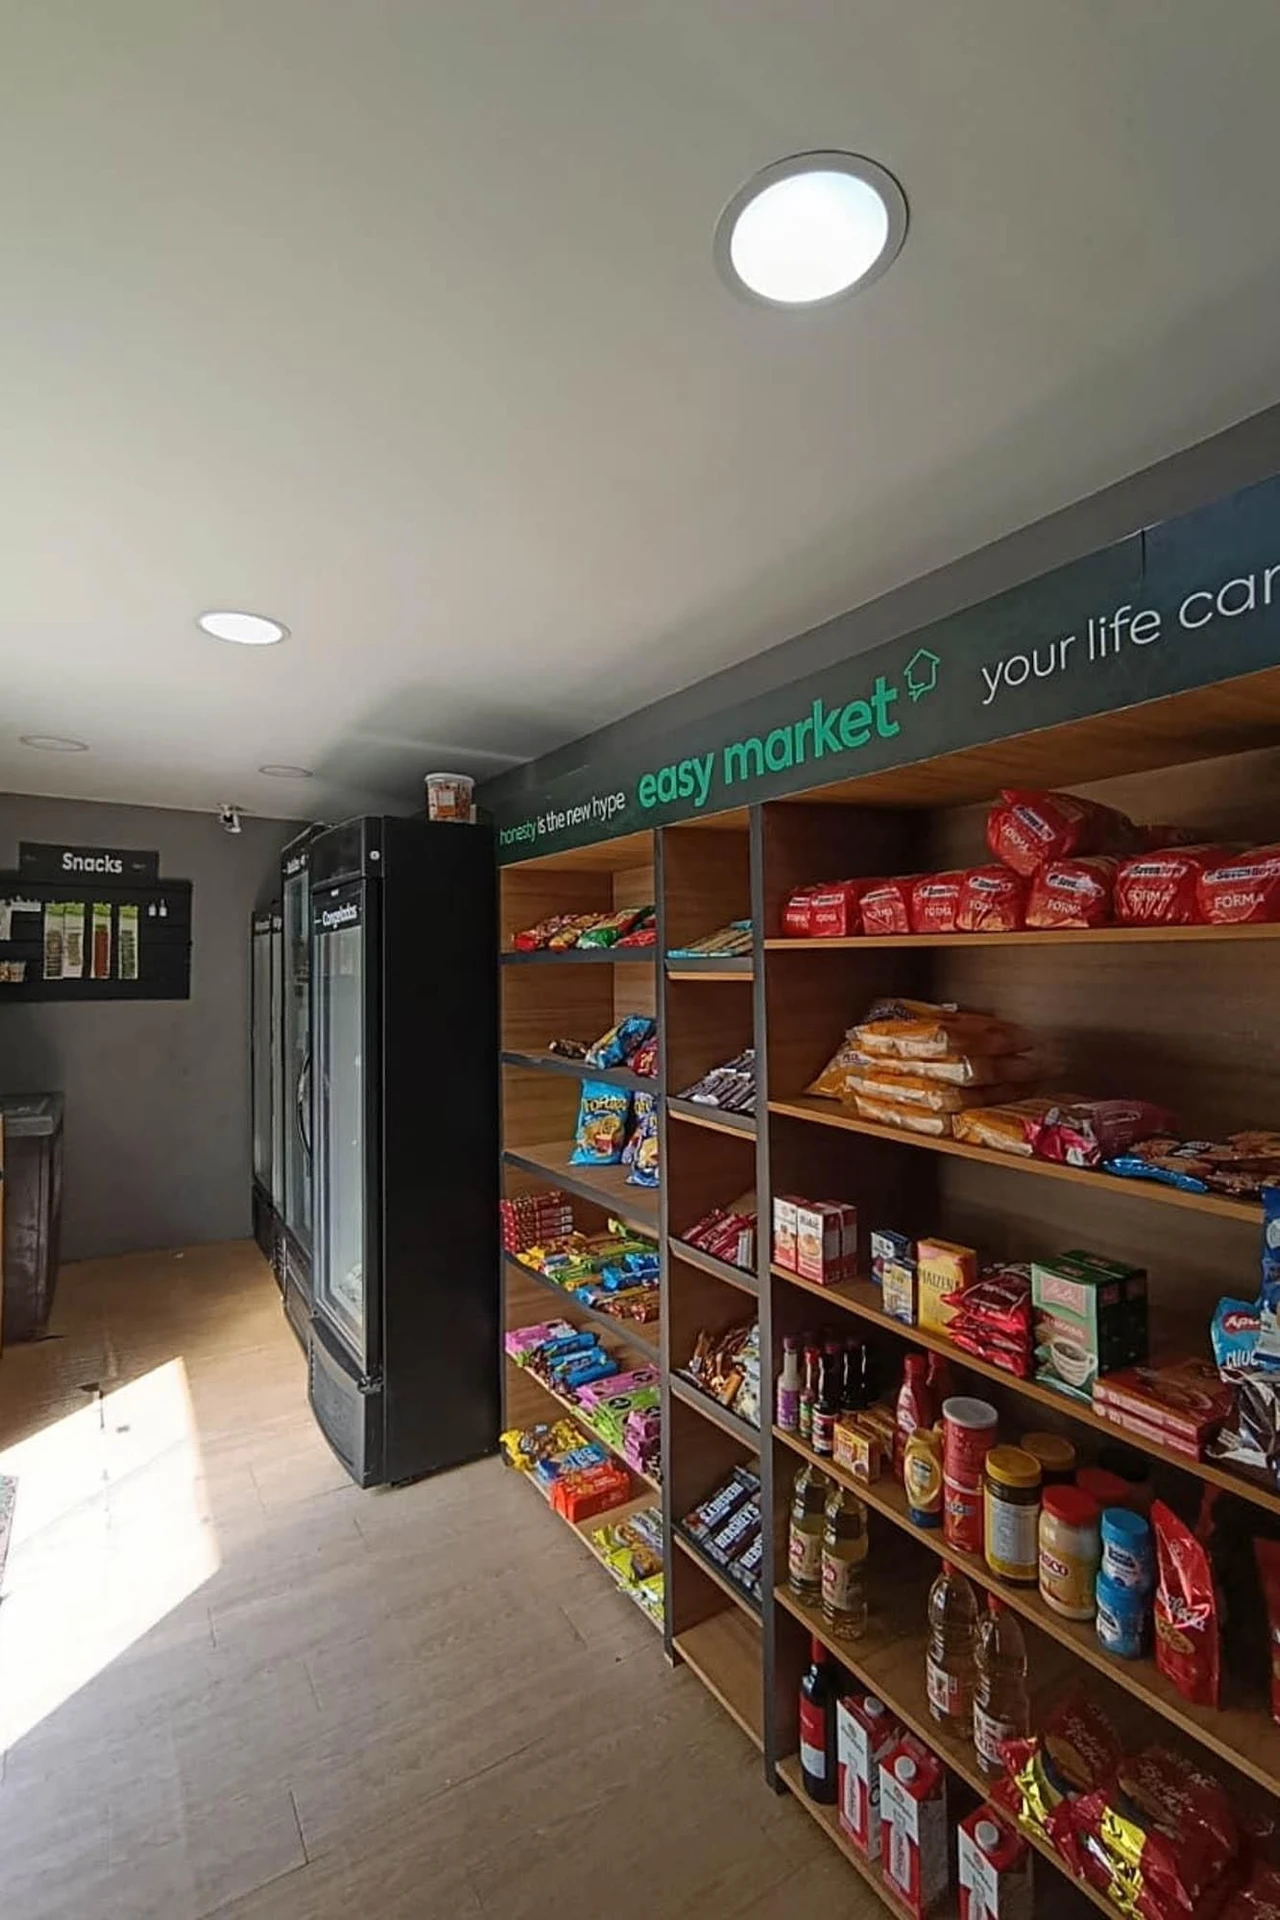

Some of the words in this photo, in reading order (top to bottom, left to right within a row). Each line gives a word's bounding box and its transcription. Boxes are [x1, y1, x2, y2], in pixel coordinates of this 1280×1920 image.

[981, 635, 1076, 705] your
[1088, 605, 1161, 661] life
[639, 752, 715, 808] easy
[725, 676, 900, 784] market
[500, 819, 536, 845] honesty
[537, 815, 546, 834] is
[546, 810, 566, 832] the
[567, 802, 591, 826] new
[592, 792, 626, 822] hype
[62, 852, 123, 873] Snacks
[1127, 889, 1170, 904] FORMA
[1214, 892, 1265, 910] FORMA
[714, 1501, 760, 1549] HERSHEY'S
